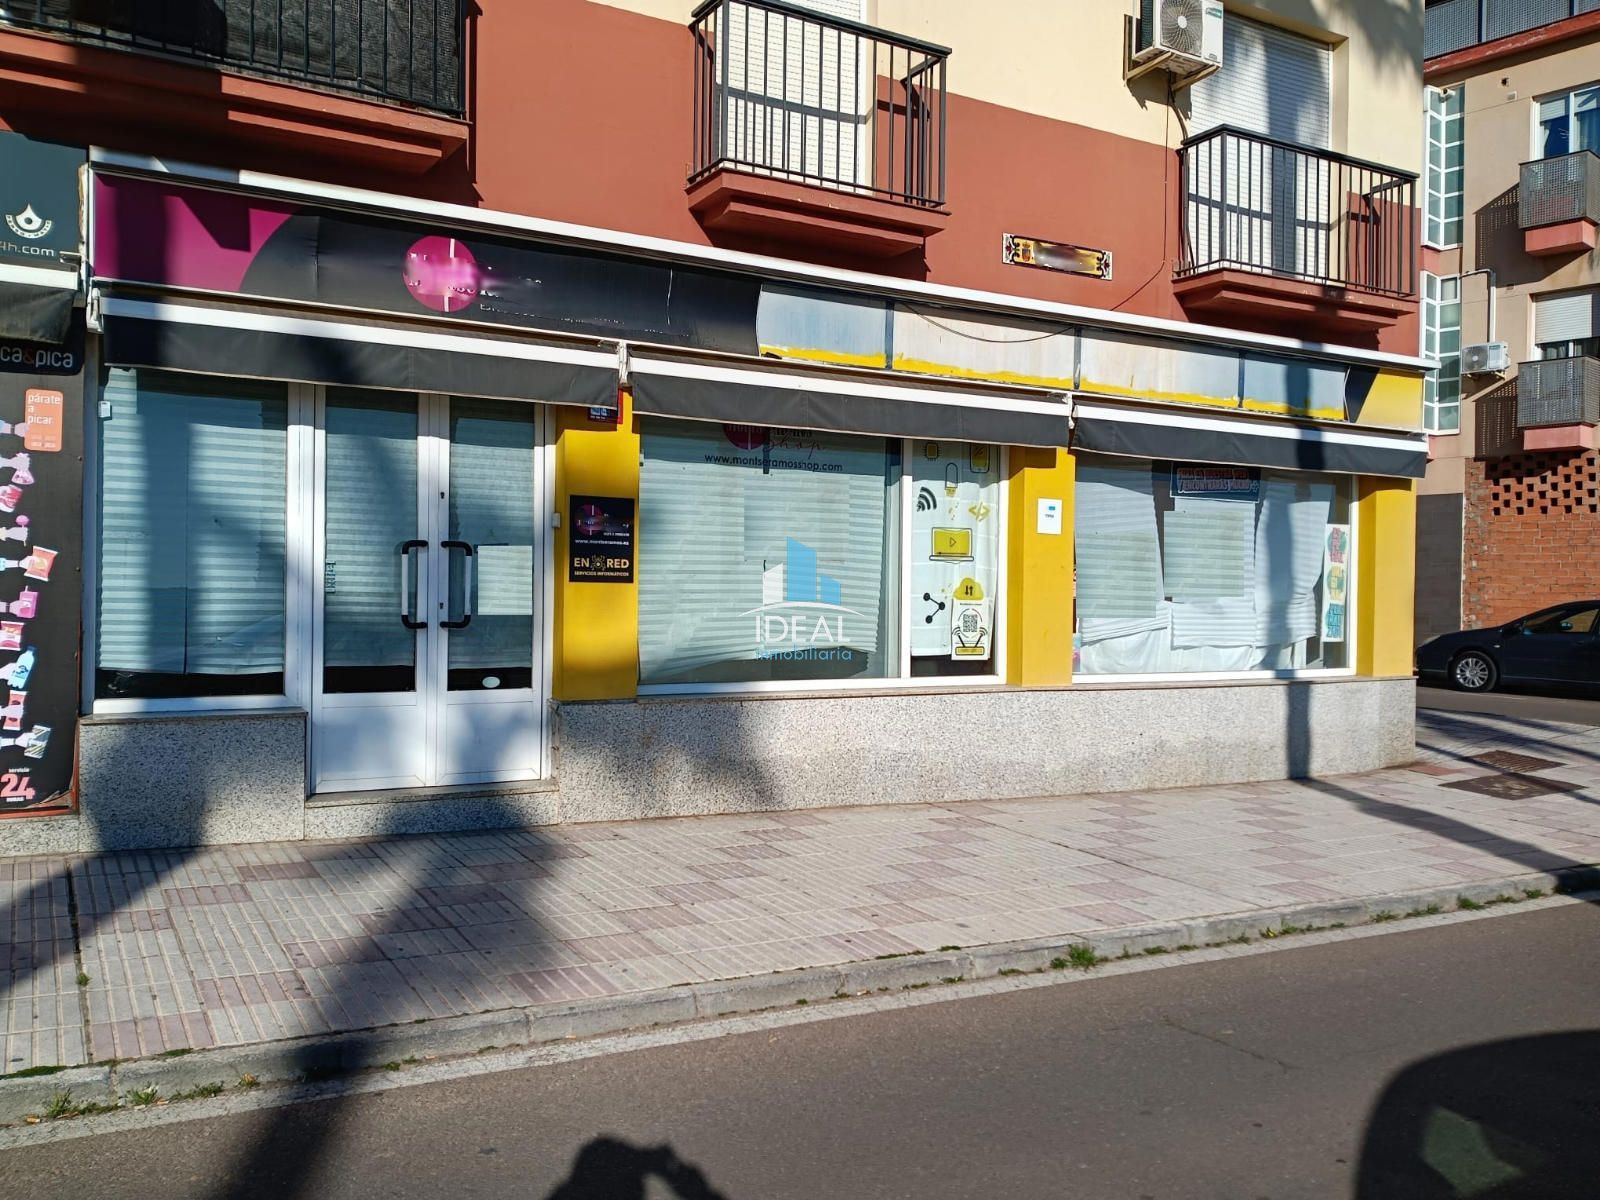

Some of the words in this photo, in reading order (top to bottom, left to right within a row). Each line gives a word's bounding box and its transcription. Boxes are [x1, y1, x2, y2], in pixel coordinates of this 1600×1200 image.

[28, 393, 61, 405] párate
[28, 405, 35, 413] a
[27, 415, 53, 425] picar
[574, 557, 590, 567] EN
[606, 558, 630, 569] RED
